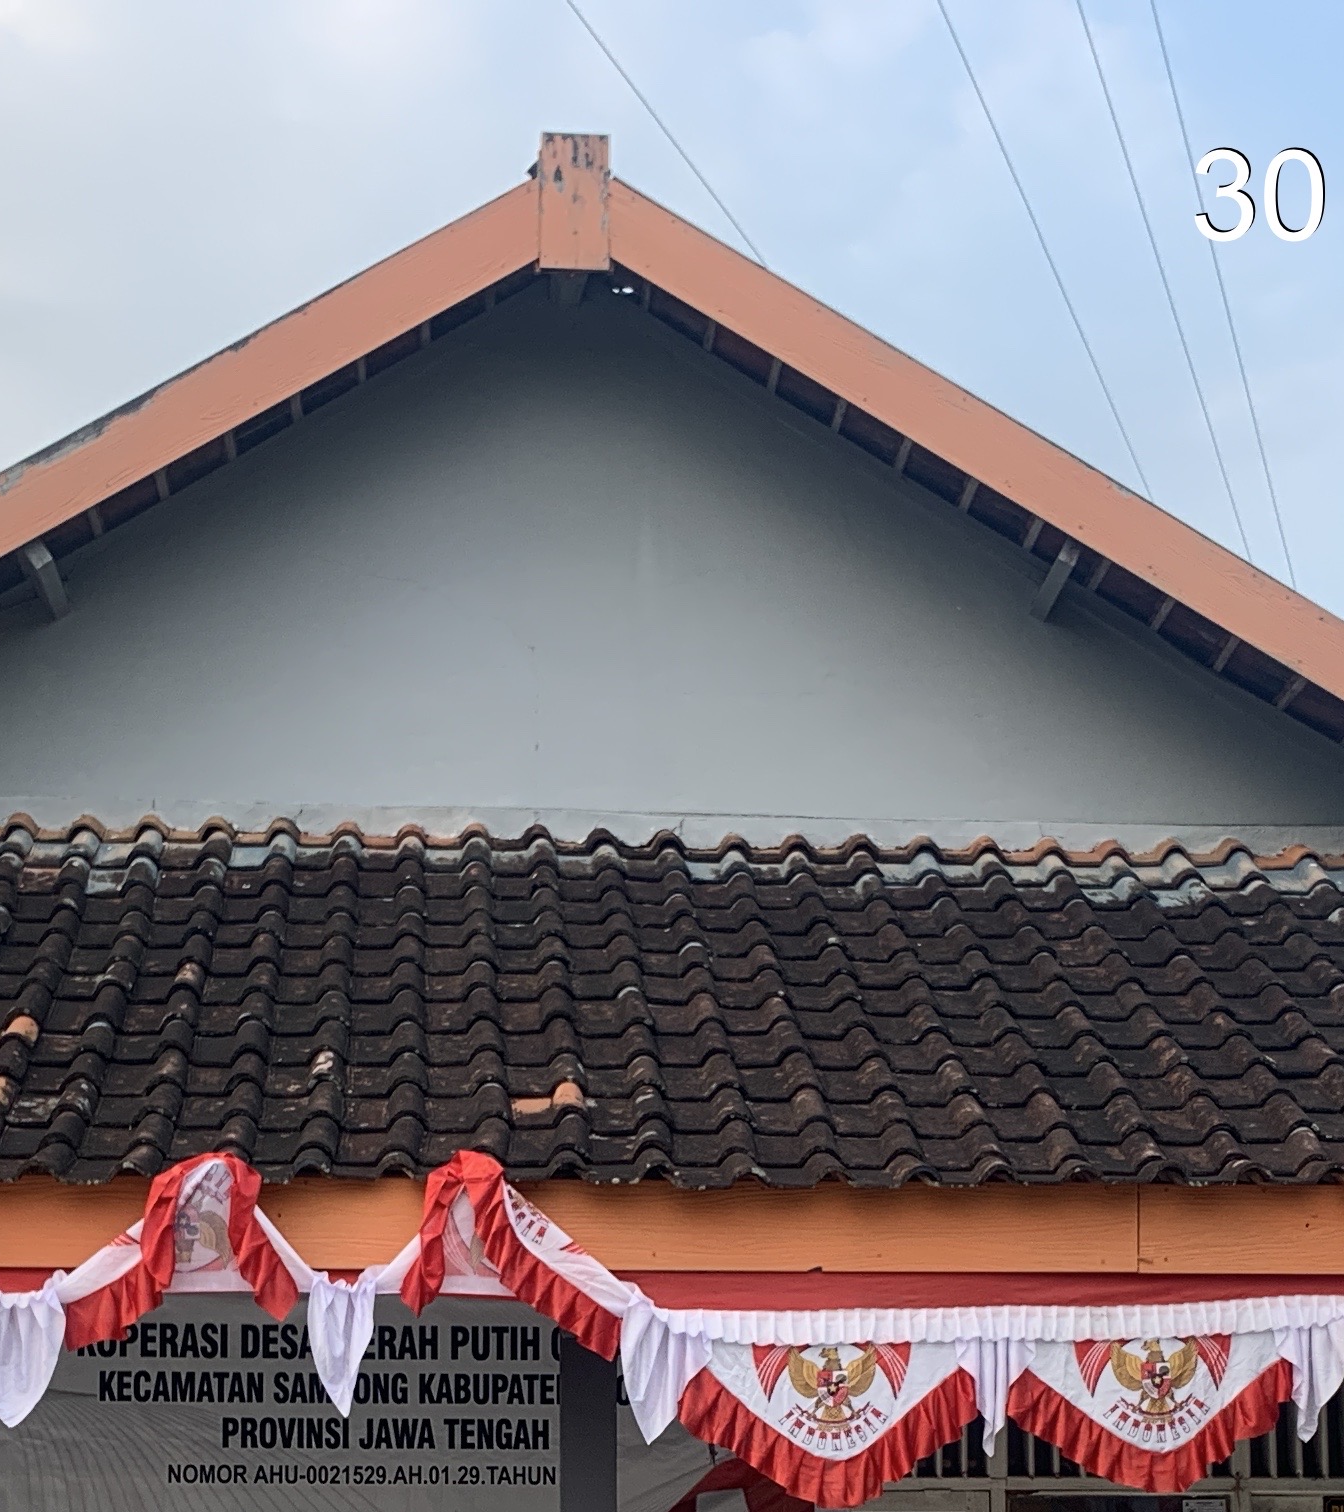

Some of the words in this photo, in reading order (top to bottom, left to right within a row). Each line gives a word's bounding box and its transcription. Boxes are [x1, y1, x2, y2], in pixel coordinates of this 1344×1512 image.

[362, 1325, 439, 1361] ERAH
[450, 1325, 540, 1361] PUTIH
[99, 1370, 264, 1403] KECAMATAN
[273, 1371, 408, 1405] SAMONG
[418, 1372, 560, 1405] KABUPATE
[222, 1416, 350, 1450] PROVINSI
[359, 1417, 436, 1450] JAWA
[443, 1417, 550, 1450] TENGAH
[778, 1406, 890, 1452] INDONESIA
[1102, 1399, 1212, 1444] INDONESIA
[167, 1464, 248, 1485] NOMOR
[254, 1465, 556, 1486] AHU-0021529.AH.01.29.TAHUN
